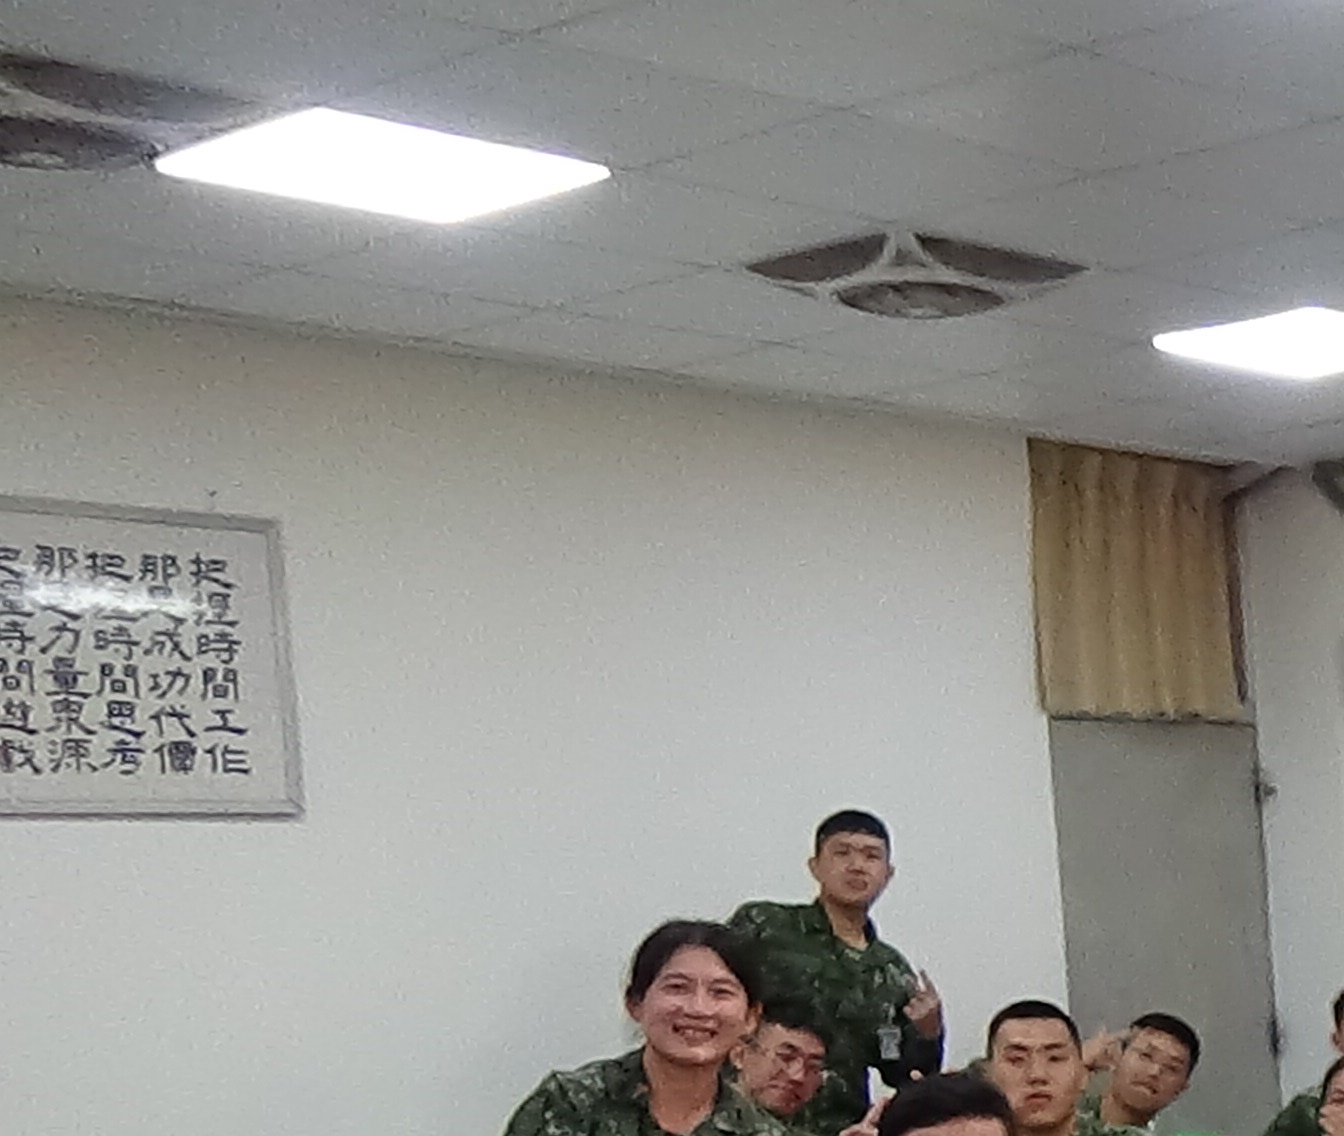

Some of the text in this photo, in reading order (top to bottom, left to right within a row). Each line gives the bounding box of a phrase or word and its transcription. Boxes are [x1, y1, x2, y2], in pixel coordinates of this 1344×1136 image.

[35, 544, 98, 775] 那力量泉源
[84, 550, 146, 776] 把時間思考
